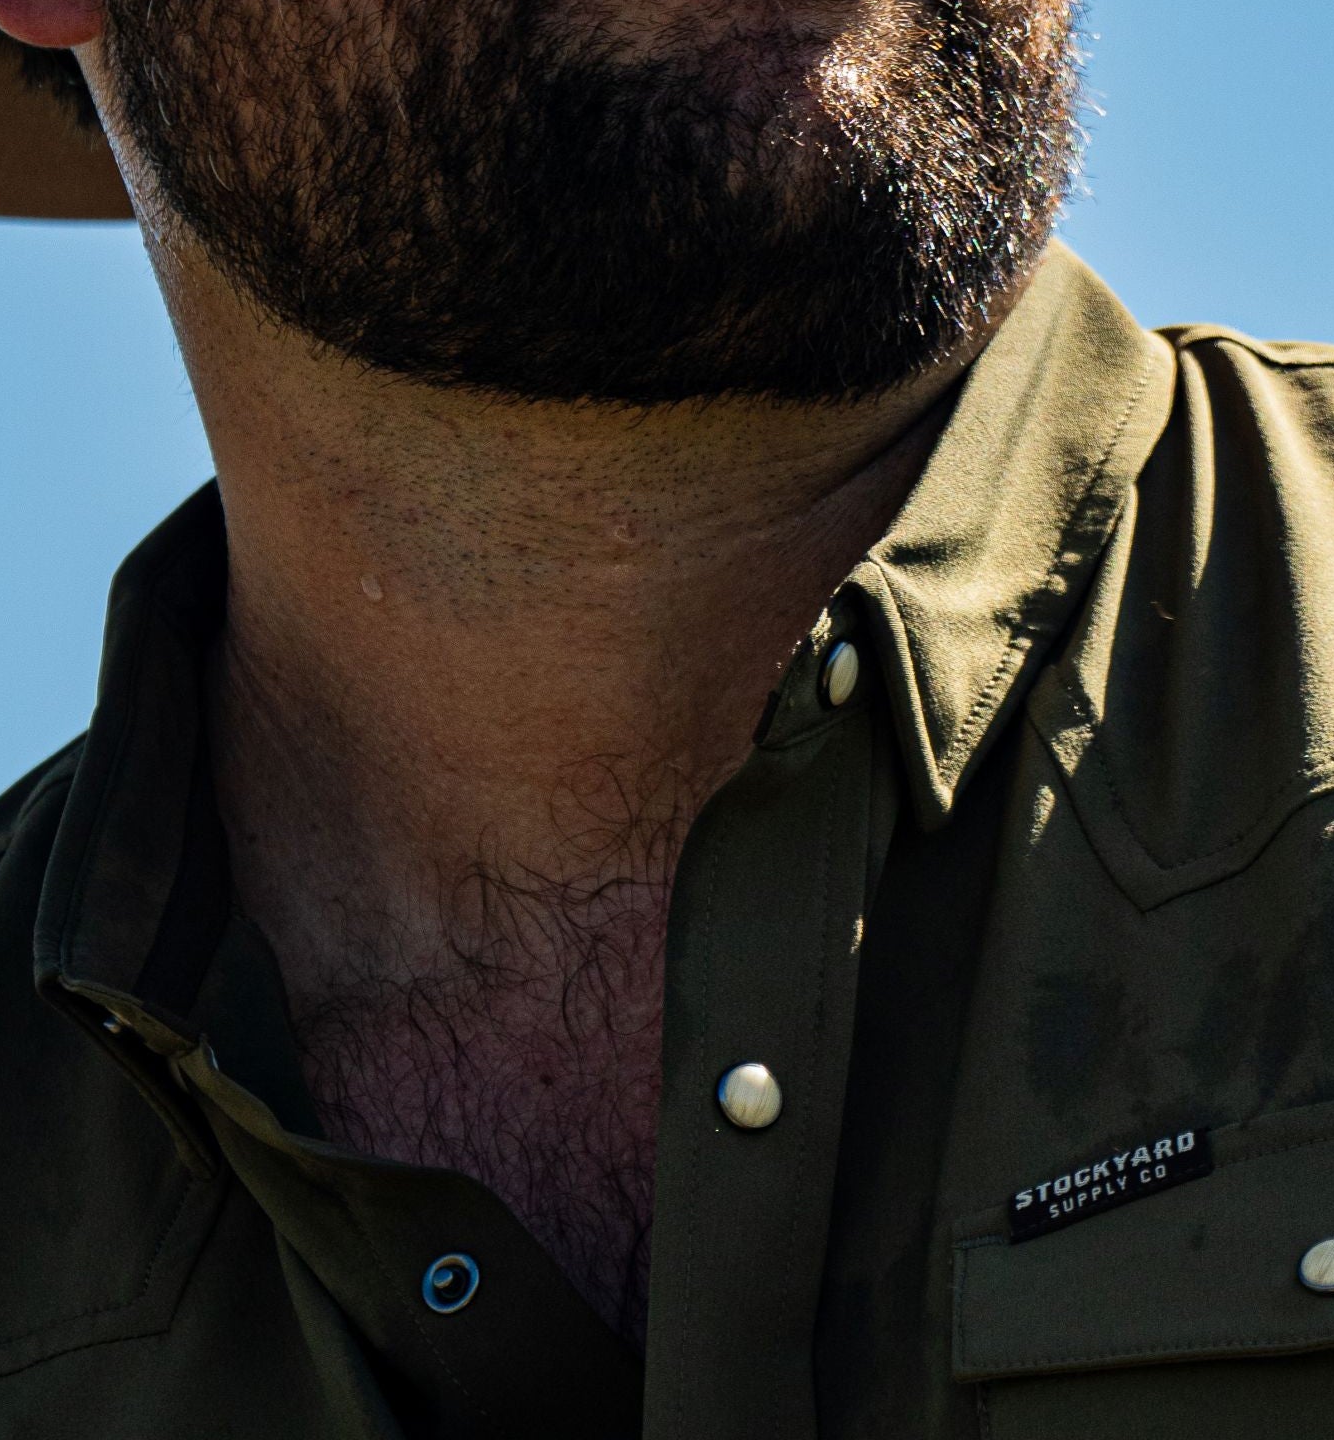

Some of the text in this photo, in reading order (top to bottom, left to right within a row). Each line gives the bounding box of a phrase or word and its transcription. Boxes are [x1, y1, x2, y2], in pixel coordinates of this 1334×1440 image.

[1015, 1131, 1195, 1210] STOCKYARD
[1049, 1164, 1167, 1219] SUPPLY CO
